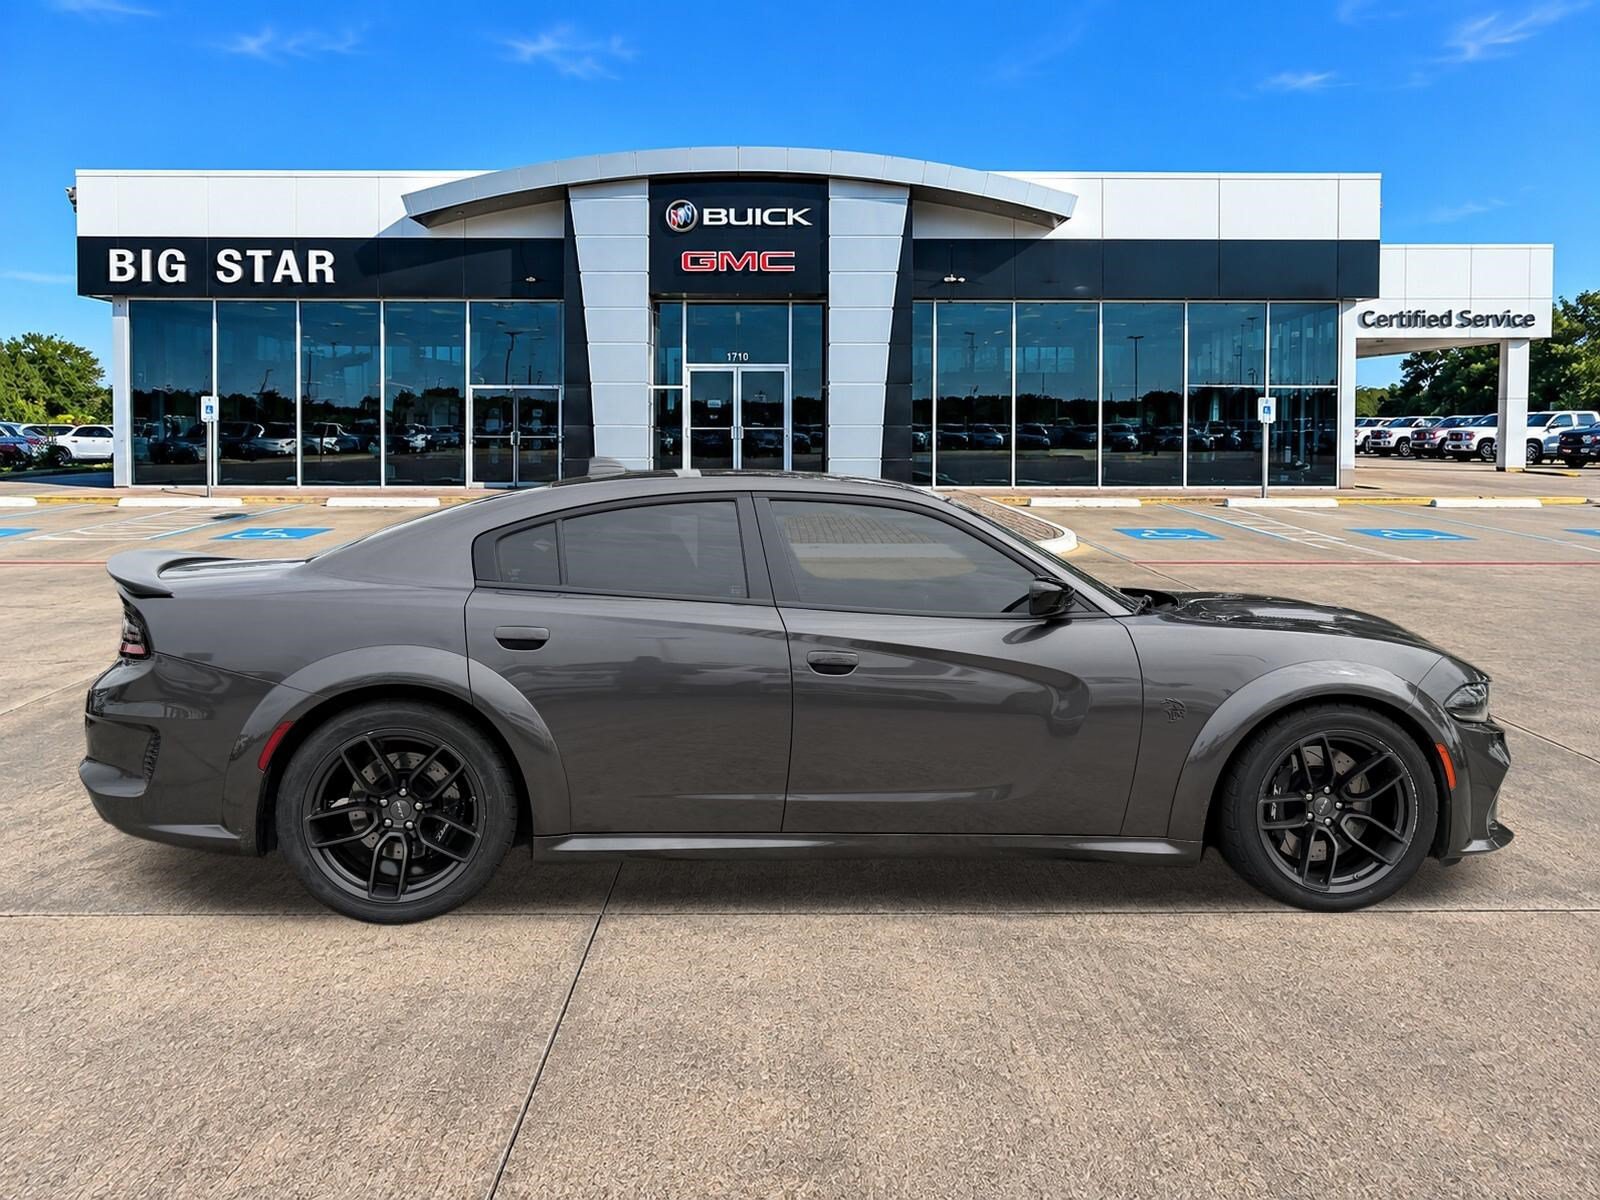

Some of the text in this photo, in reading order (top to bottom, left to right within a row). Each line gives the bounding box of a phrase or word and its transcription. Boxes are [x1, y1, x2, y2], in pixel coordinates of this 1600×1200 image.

[703, 208, 813, 225] BUICK
[109, 249, 336, 283] BIG STAR
[681, 251, 795, 272] GMC
[1360, 309, 1536, 328] Certified Service
[727, 352, 749, 361] 1710
